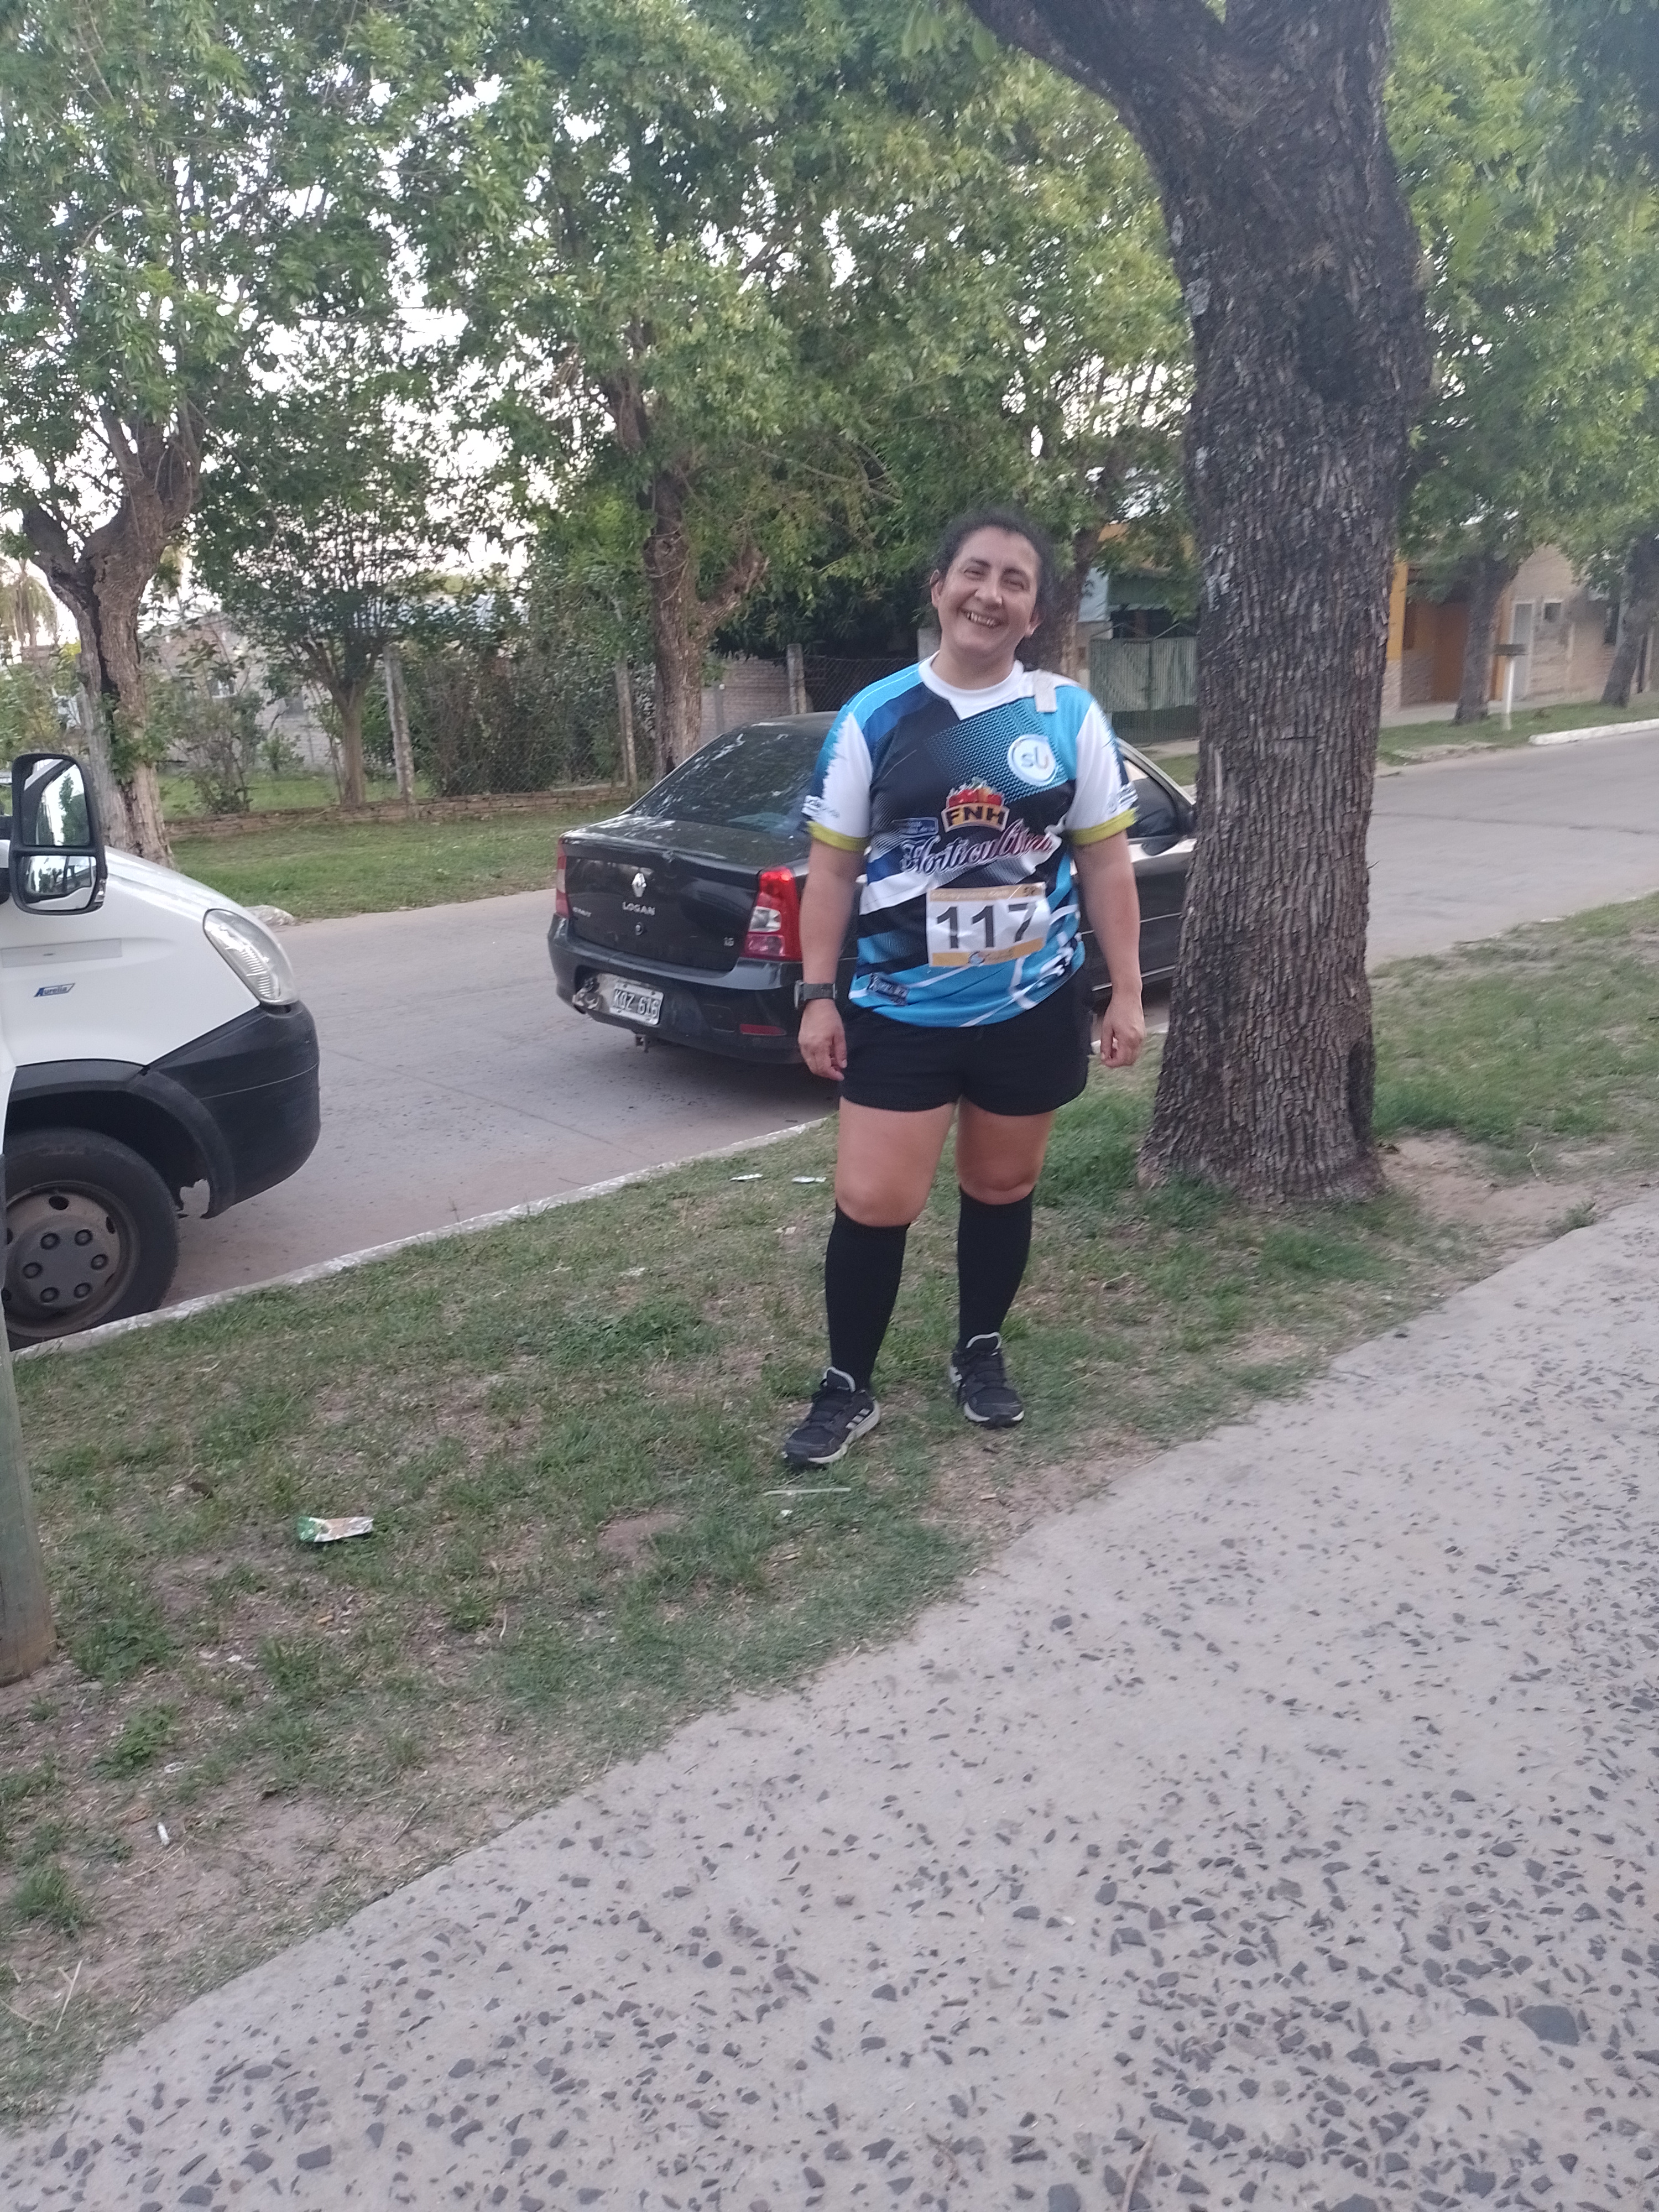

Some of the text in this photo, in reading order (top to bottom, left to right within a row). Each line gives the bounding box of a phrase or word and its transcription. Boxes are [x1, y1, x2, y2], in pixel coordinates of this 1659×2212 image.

[946, 806, 1005, 828] FNH
[622, 901, 655, 916] LOGAN
[936, 903, 1037, 948] 117
